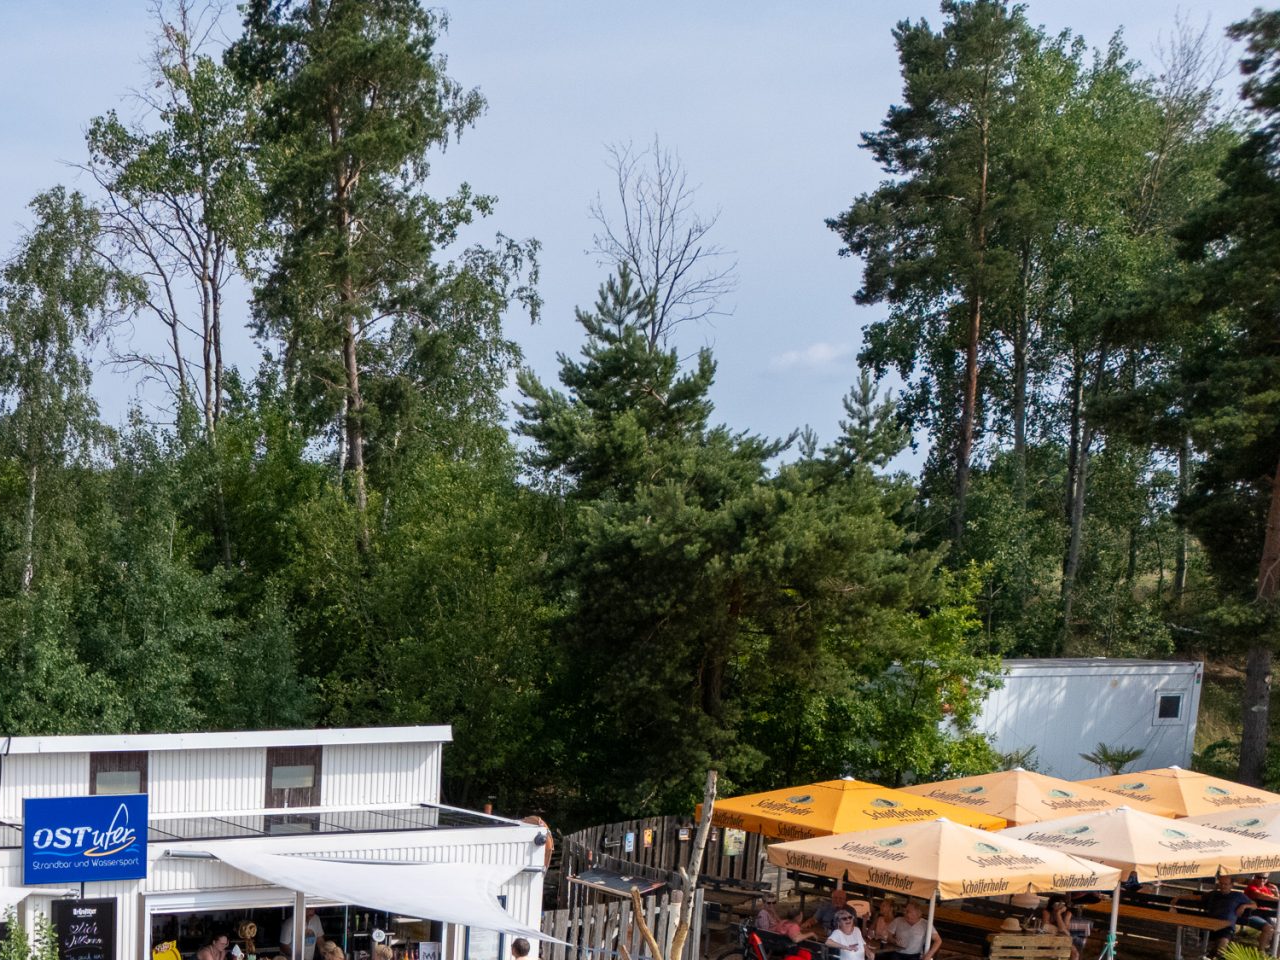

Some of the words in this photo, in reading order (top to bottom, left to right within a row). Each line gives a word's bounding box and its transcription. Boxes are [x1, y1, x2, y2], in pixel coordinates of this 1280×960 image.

[862, 807, 939, 822] Schöfferhofer
[33, 860, 71, 870] Strandbar
[74, 859, 90, 868] und
[91, 858, 139, 868] Wassersport
[786, 851, 828, 872] Schöfferhofer
[1155, 861, 1200, 878] Schöfferhofer
[866, 867, 915, 890] Schöfferhofer
[960, 878, 1009, 896] Schöfferhofer
[1050, 873, 1099, 890] Schöfferhofer
